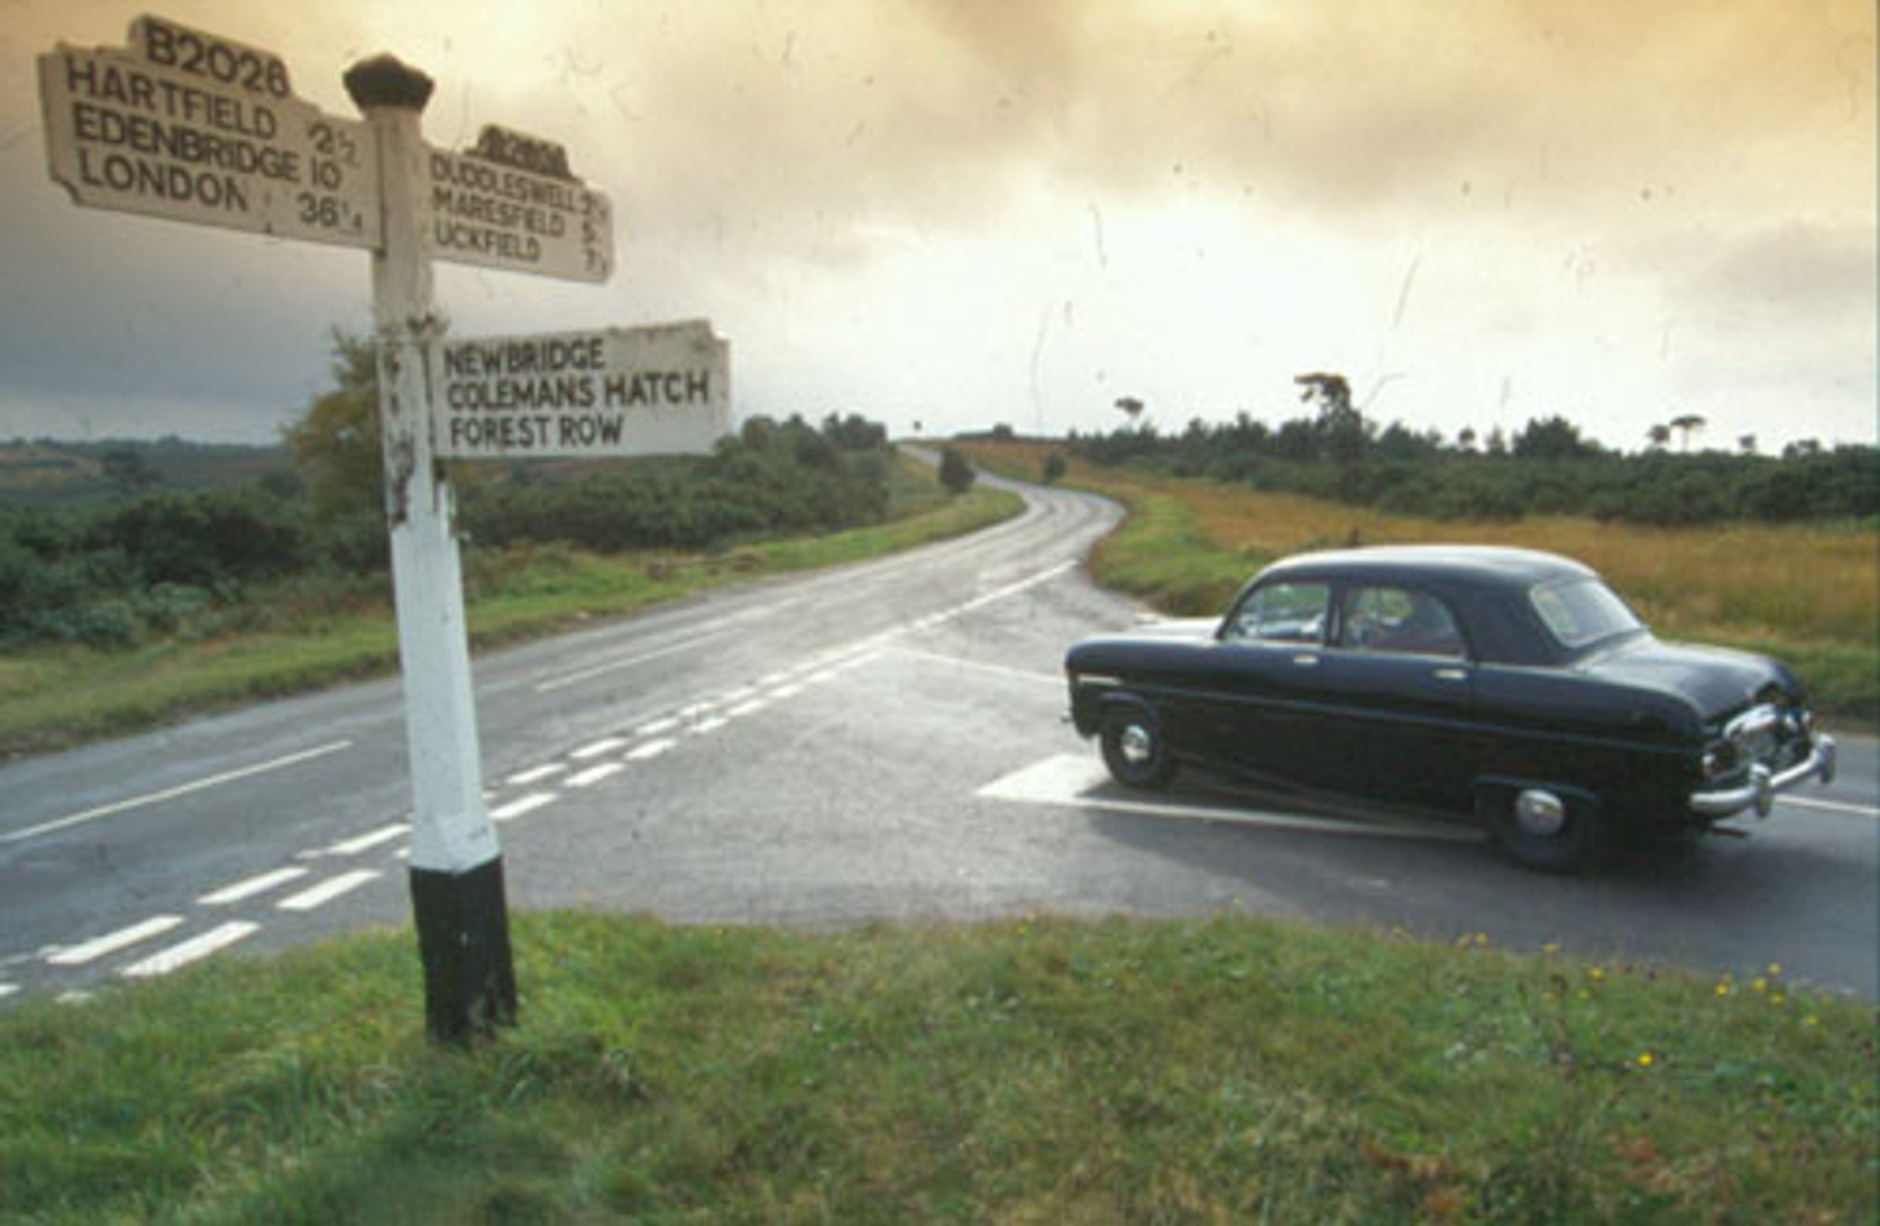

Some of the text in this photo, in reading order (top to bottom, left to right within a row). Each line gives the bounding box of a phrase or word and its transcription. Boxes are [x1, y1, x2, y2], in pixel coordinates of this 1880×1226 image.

[66, 54, 276, 140] HARTFIELD
[73, 102, 300, 183] EDENBRIDGE
[79, 148, 249, 212] LONDON
[432, 153, 575, 212] DUDDLESWELL
[433, 185, 564, 238] MARESFIELD
[436, 217, 542, 262] UCKFIELD
[444, 338, 605, 376] NEWBRIDGE
[447, 370, 710, 410] COLEMANS HATCH
[450, 414, 624, 448] FOREST ROW
